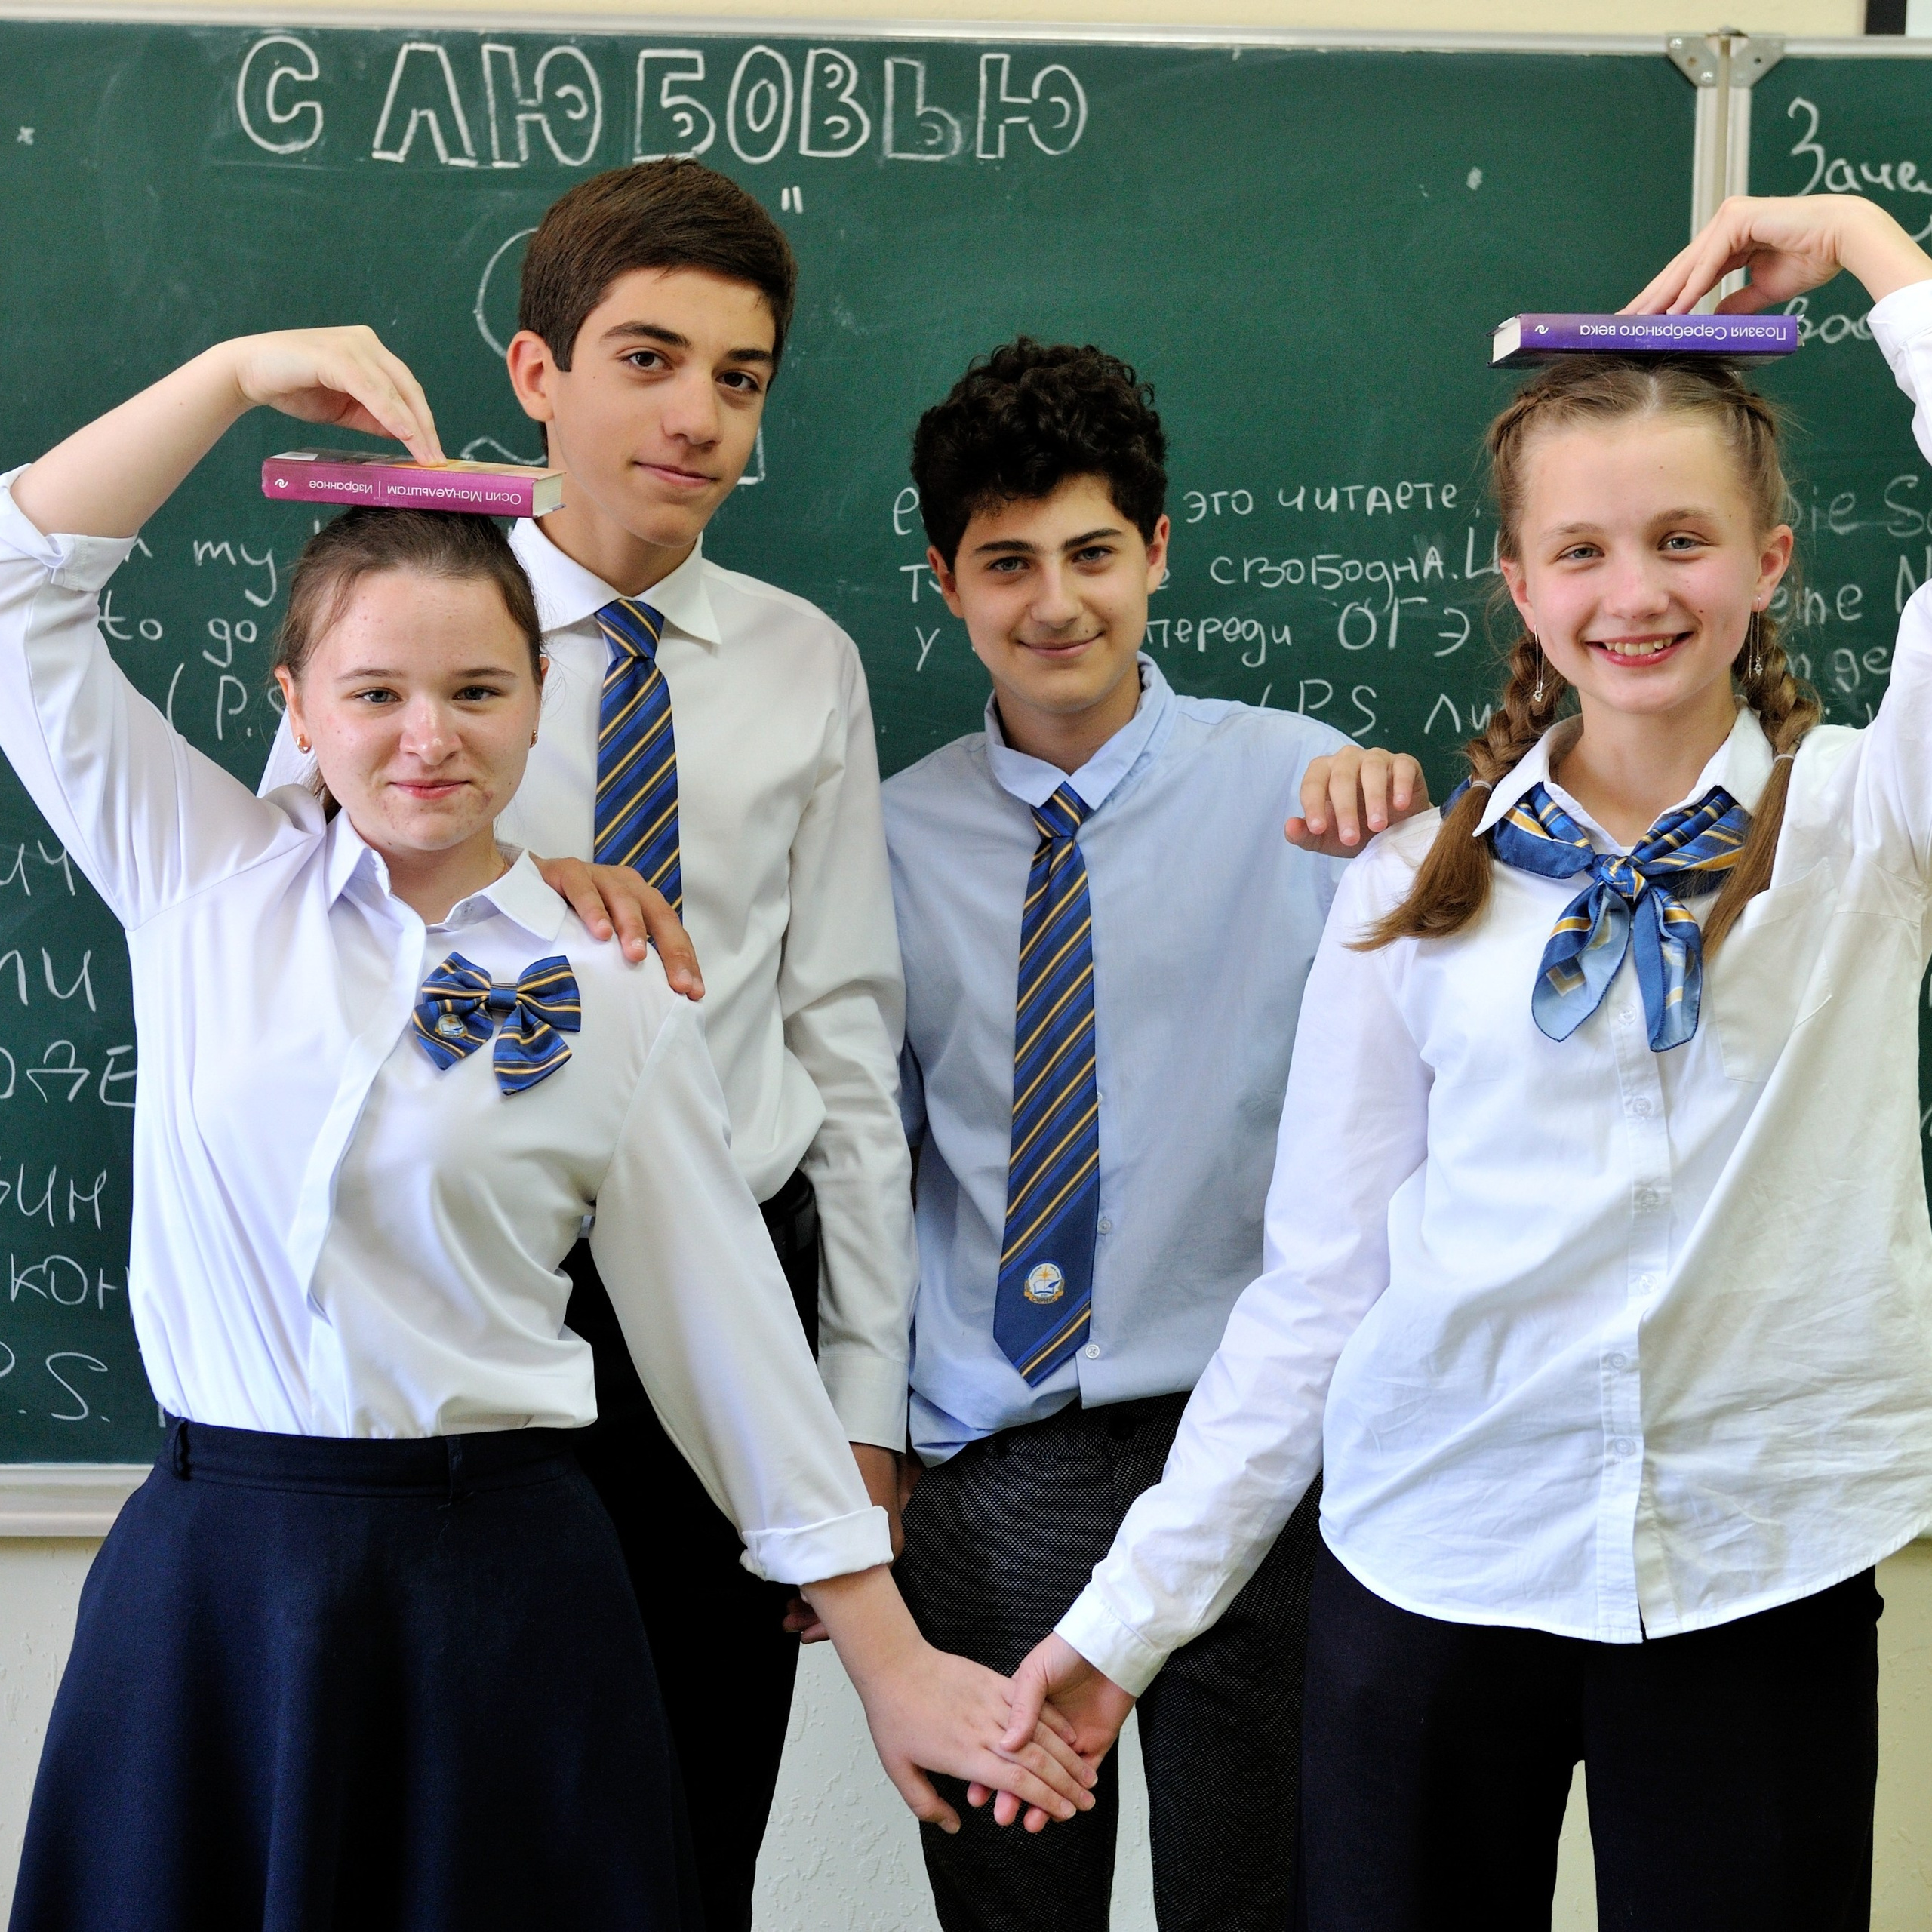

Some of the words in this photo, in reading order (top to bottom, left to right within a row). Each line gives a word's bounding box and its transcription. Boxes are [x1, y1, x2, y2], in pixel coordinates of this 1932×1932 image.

[236, 35, 324, 154] С
[372, 42, 1088, 167] ЛЮБОВЬЮ
[1787, 96, 1932, 198] Заче
[1579, 325, 1616, 336] века
[1620, 325, 1727, 340] Серебряного
[1730, 326, 1787, 341] Поэзия
[309, 479, 373, 494] Избранное
[386, 485, 482, 503] Мандельштам
[485, 492, 522, 506] Осип
[1183, 488, 1254, 524] это
[193, 539, 277, 607] my
[202, 617, 257, 669] go
[1145, 616, 1292, 668] переди
